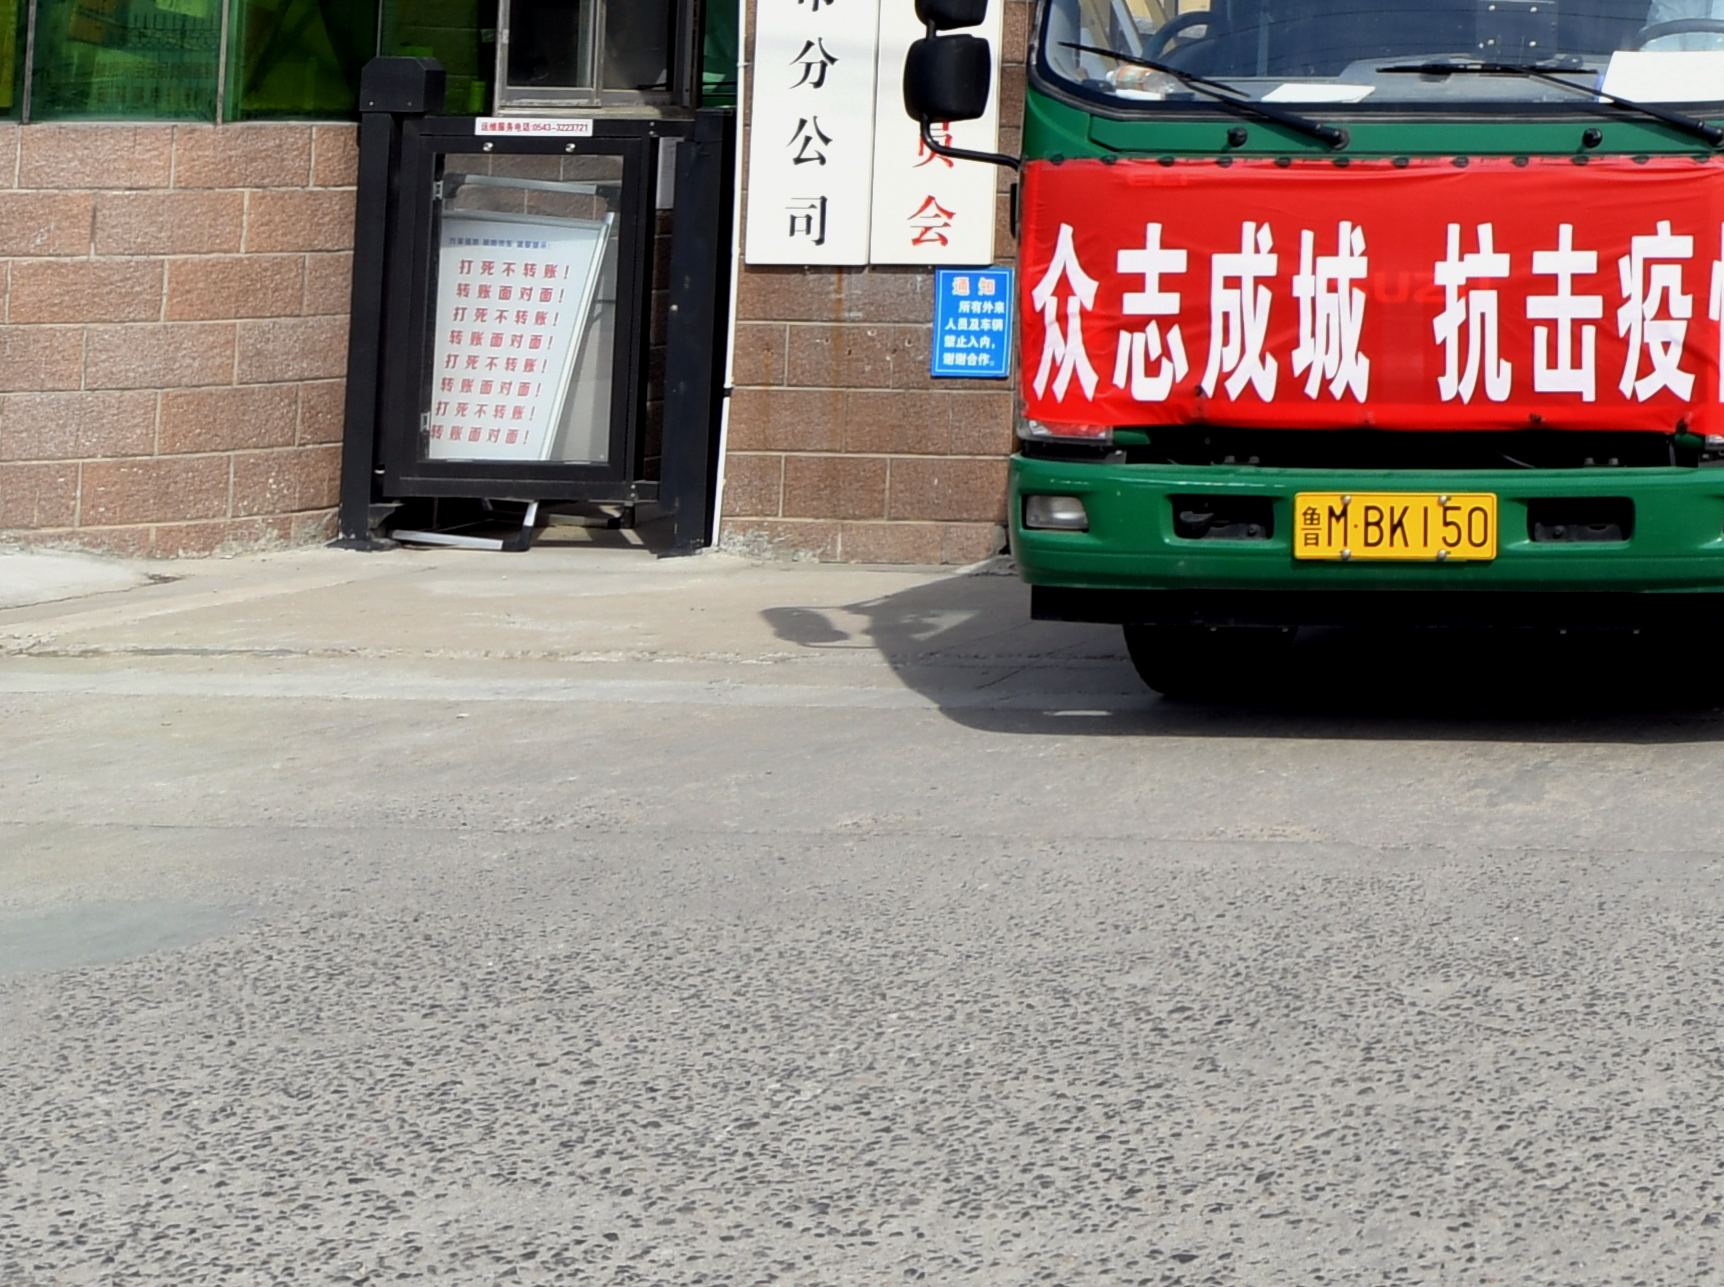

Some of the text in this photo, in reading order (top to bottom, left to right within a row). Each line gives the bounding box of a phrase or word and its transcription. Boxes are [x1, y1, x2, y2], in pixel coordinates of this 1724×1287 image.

[952, 276, 996, 296] 通知
[958, 301, 1005, 314] 所有外来
[1032, 221, 1371, 404] 众志成城
[944, 318, 1004, 332] 人员及车辆
